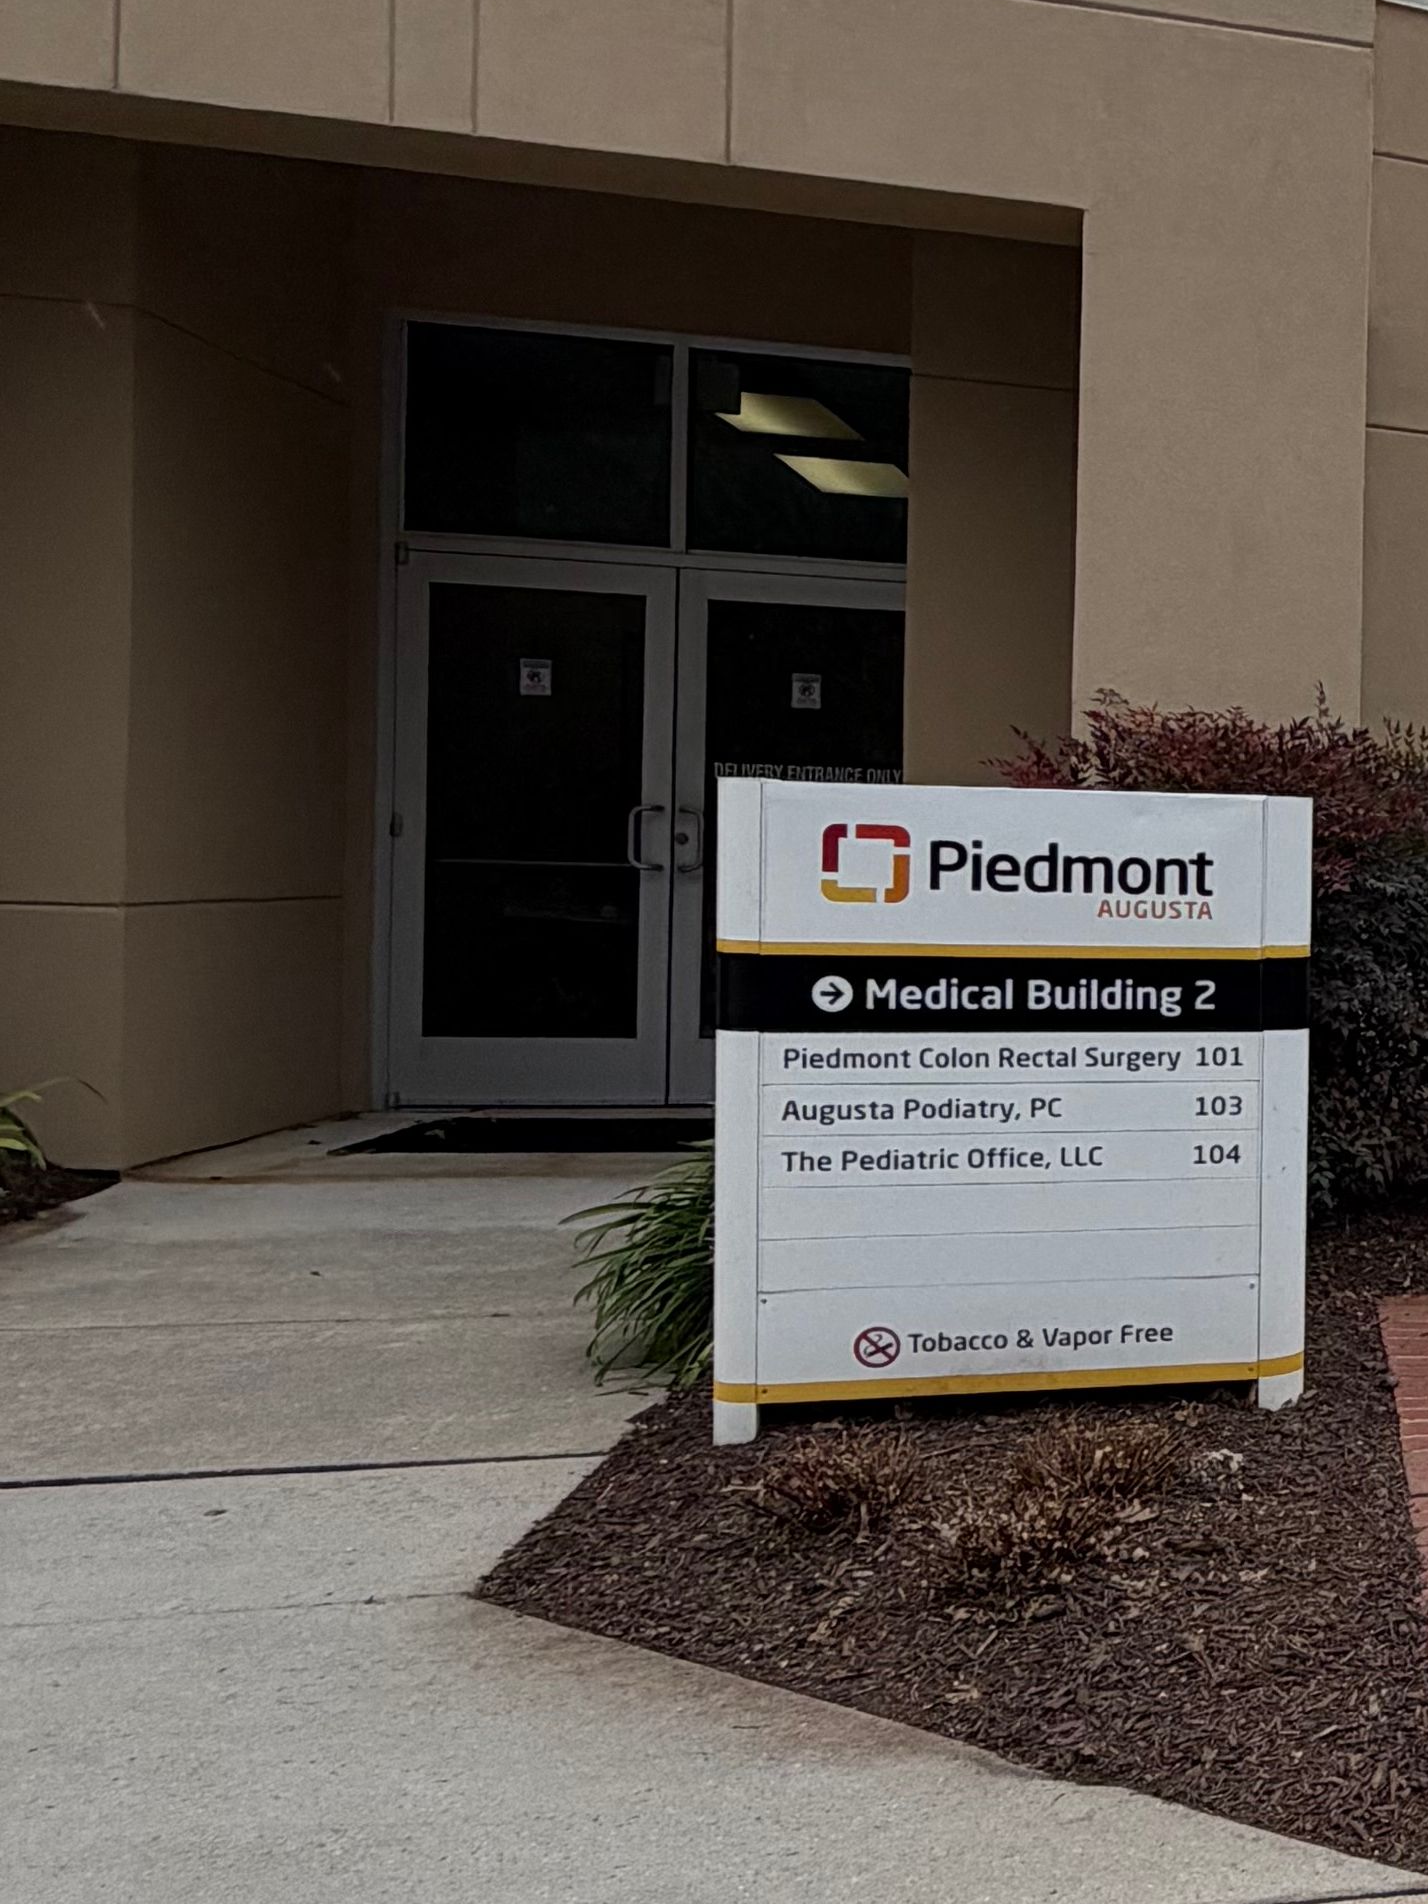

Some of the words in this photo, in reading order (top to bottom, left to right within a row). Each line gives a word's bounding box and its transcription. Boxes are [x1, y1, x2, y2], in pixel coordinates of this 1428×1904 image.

[714, 762, 783, 778] DELIVERY
[787, 765, 863, 782] ENTRANCE
[866, 768, 901, 784] ONLY
[929, 839, 1214, 897] Piedmont
[1097, 899, 1213, 921] AUGUSTA
[866, 977, 1014, 1010] Medical
[1027, 978, 1182, 1017] Building
[1194, 980, 1216, 1010] 2
[783, 1047, 911, 1069] Piedmont
[919, 1047, 990, 1069] Colon
[998, 1046, 1077, 1068] Rectal
[1084, 1047, 1181, 1072] Surgery
[1196, 1046, 1244, 1067] 101
[781, 1100, 894, 1126] Augusta
[903, 1098, 1021, 1124] Podiatry,
[1030, 1097, 1062, 1118] PC
[1195, 1095, 1243, 1116] 103
[781, 1151, 832, 1172] The
[841, 1148, 960, 1171] Pediatric
[967, 1147, 1051, 1170] Office,
[1060, 1146, 1103, 1167] LLC
[1193, 1144, 1241, 1165] 104
[907, 1332, 1009, 1354] Tobacco
[1016, 1329, 1034, 1349] &
[1042, 1327, 1113, 1351] Vapor
[1120, 1324, 1173, 1344] Free
